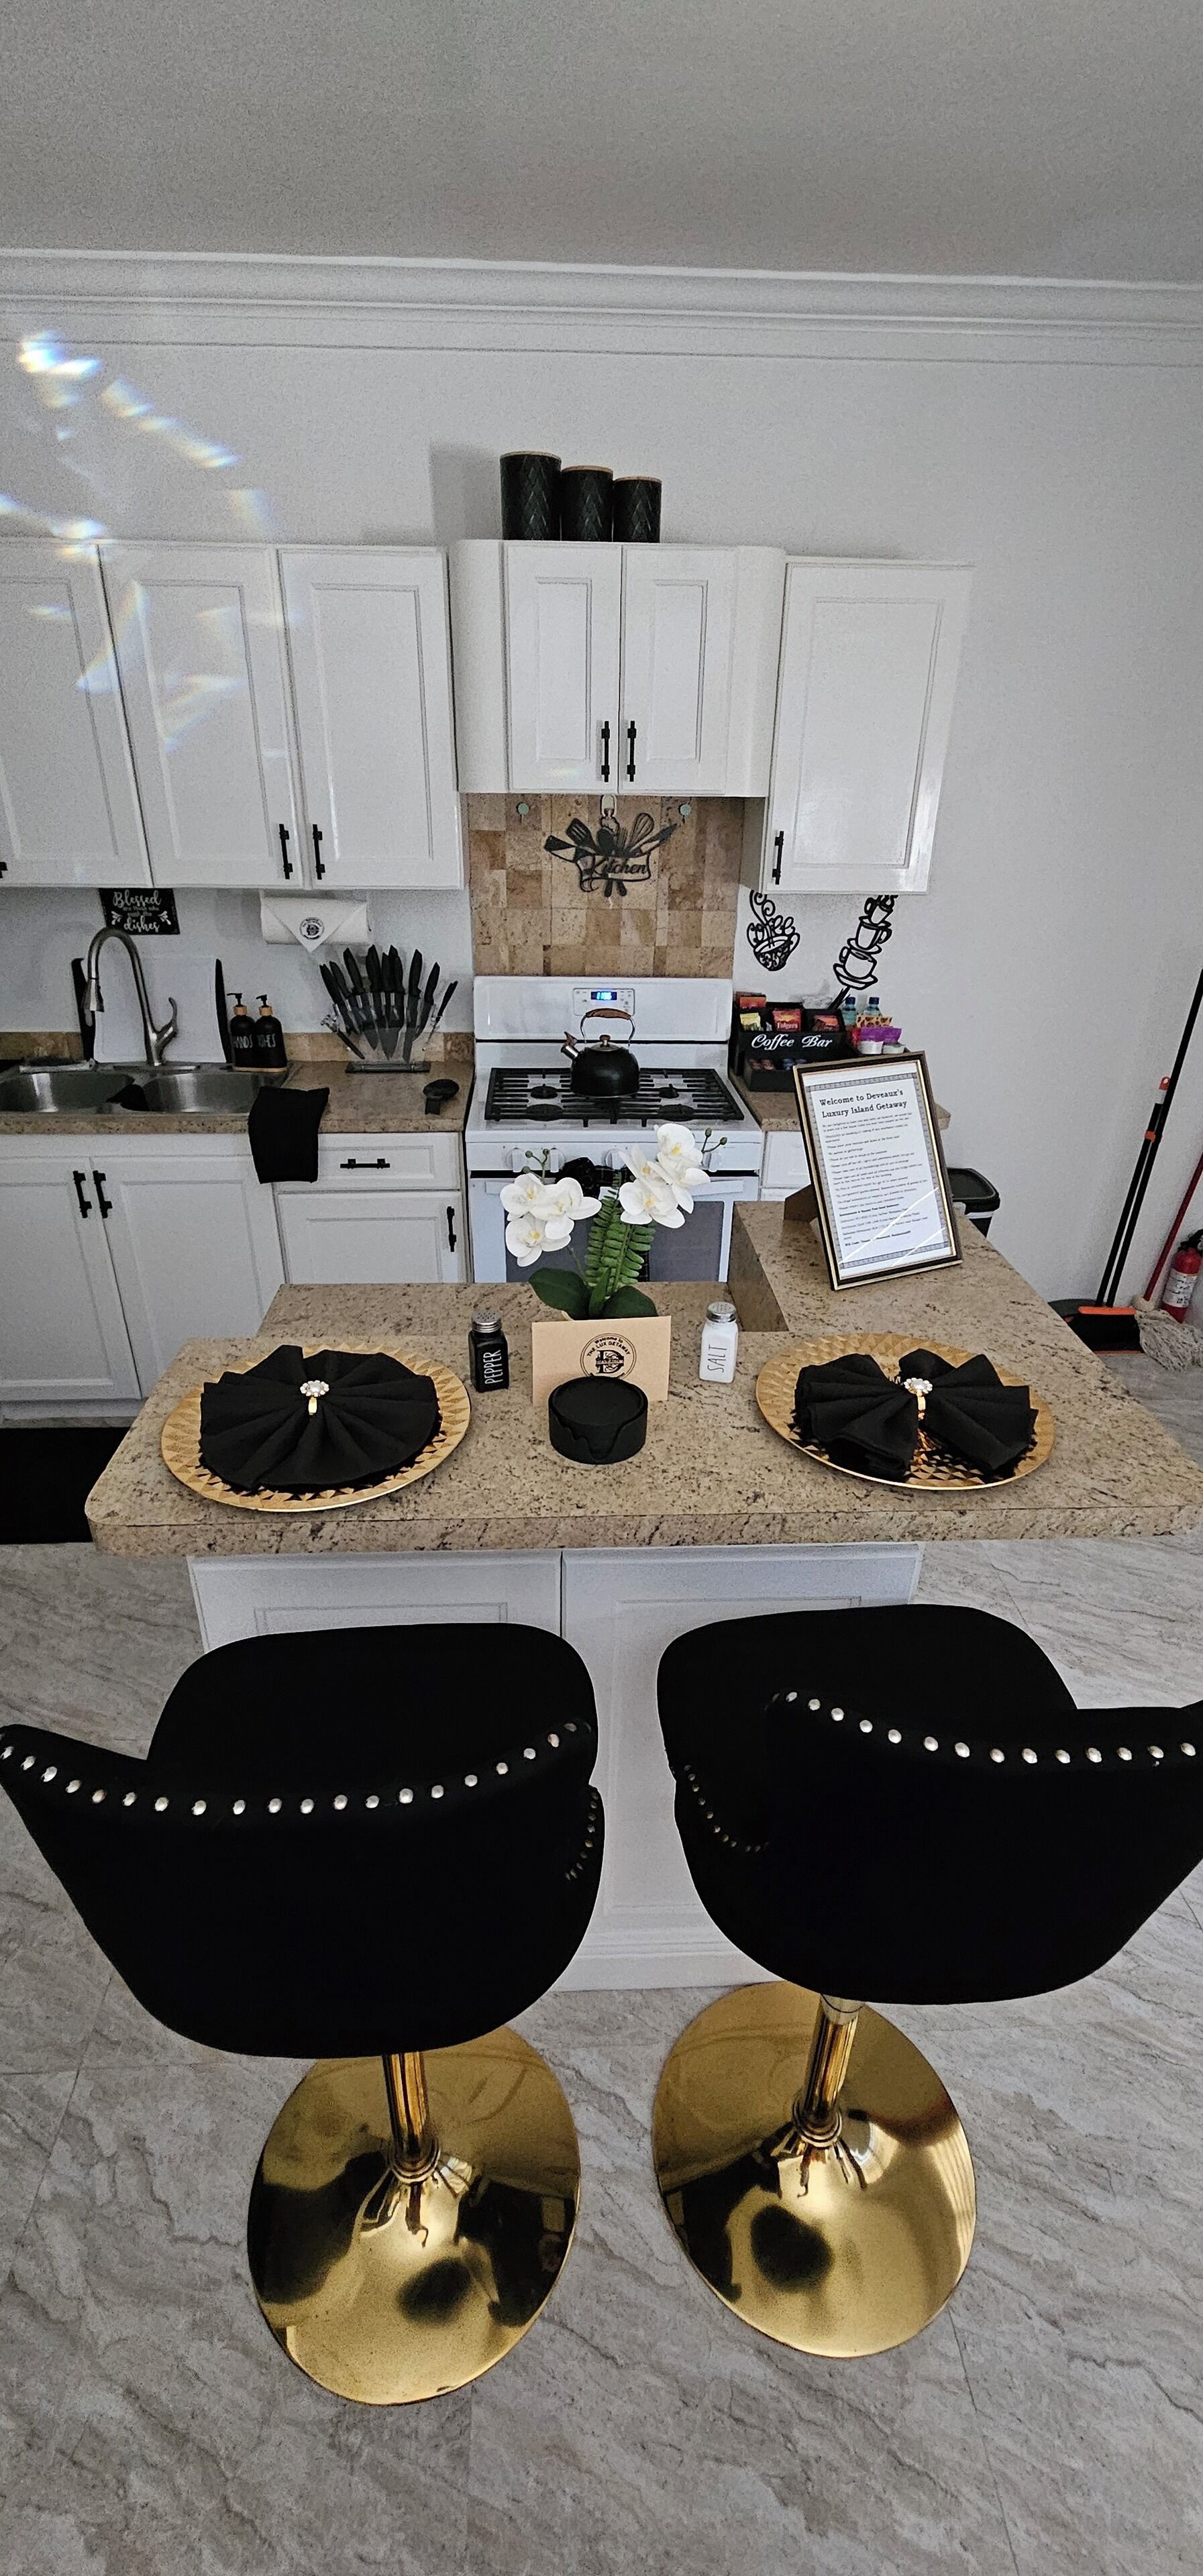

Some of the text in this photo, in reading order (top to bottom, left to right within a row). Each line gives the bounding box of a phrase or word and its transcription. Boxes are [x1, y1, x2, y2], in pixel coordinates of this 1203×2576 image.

[592, 856, 648, 876] Kitchen
[113, 889, 162, 908] Blessed
[123, 915, 160, 932] dishes
[751, 1033, 833, 1051] Coffee Bar
[819, 1096, 854, 1106] Welcome
[866, 1089, 904, 1100] Deveaux's
[822, 1101, 907, 1118] Luxury Island Getaway
[586, 1347, 597, 1357] THE
[608, 1340, 631, 1355] GETAWAY
[484, 1349, 502, 1385] PEPPER
[707, 1343, 728, 1374] SALT
